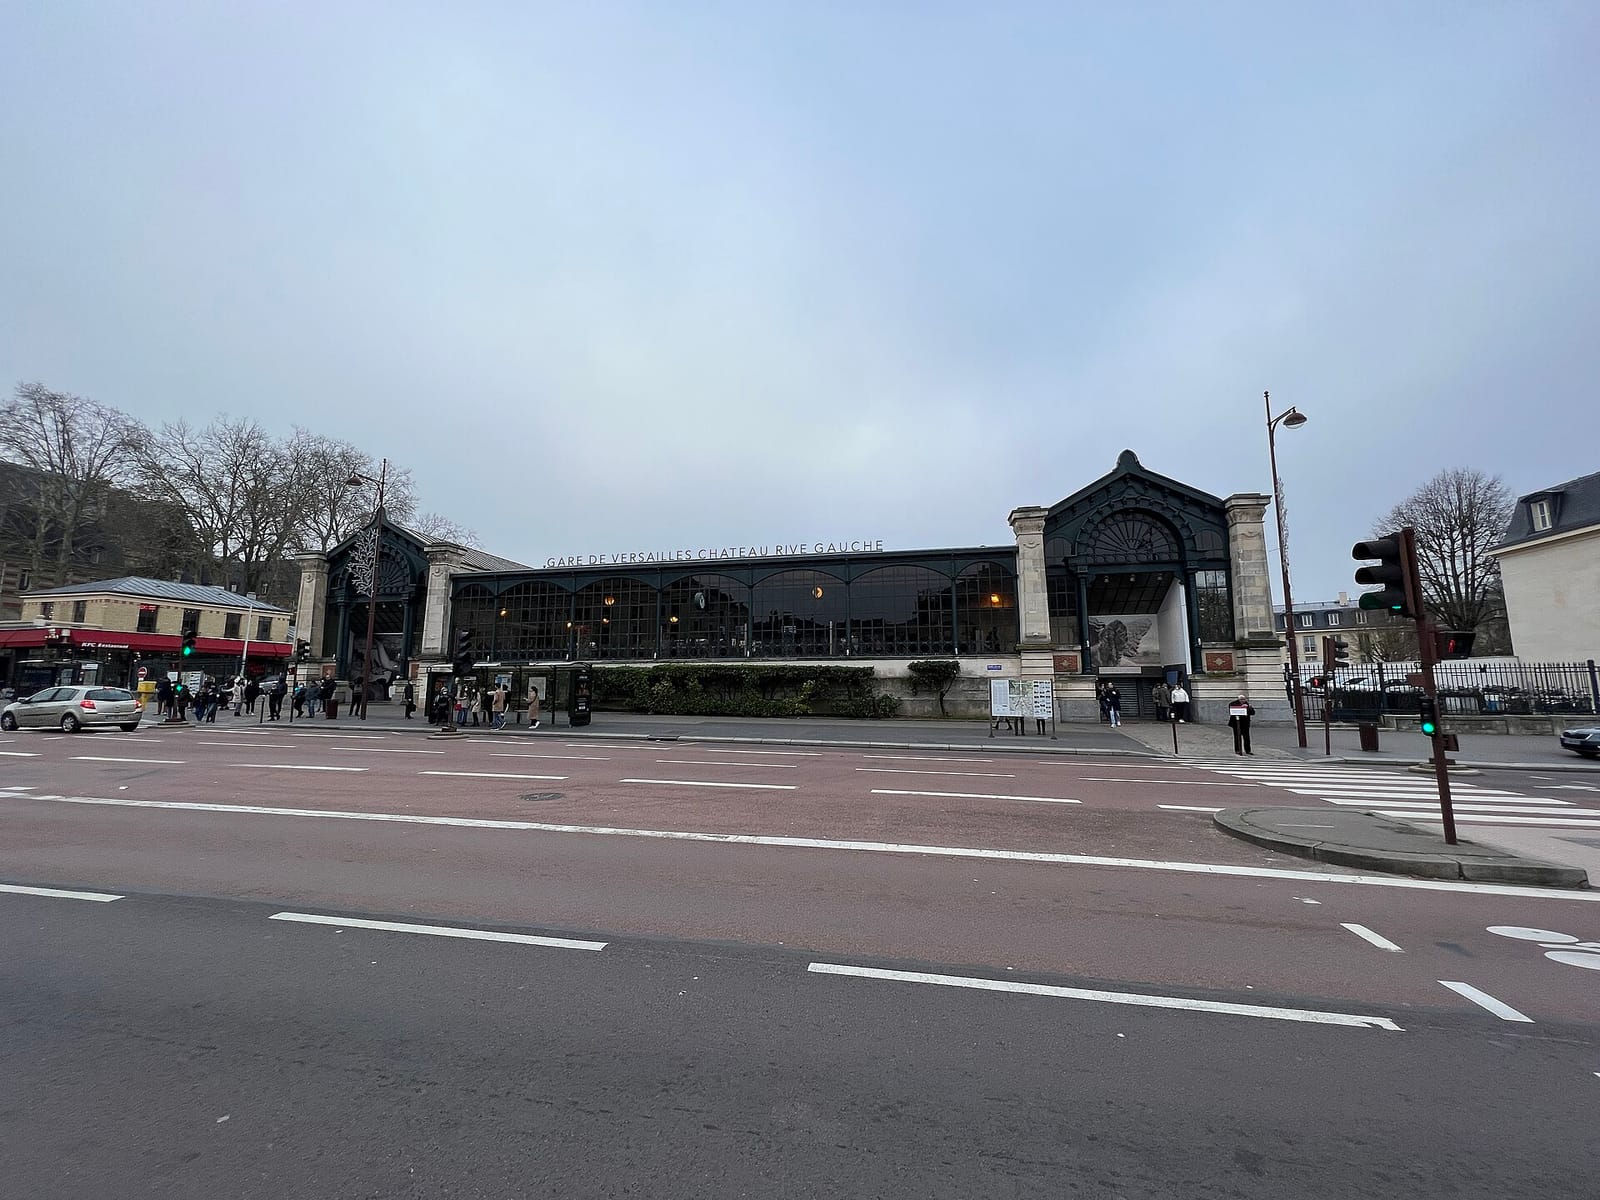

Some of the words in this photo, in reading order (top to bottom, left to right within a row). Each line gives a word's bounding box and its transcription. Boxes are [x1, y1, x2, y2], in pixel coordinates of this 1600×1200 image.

[546, 556, 583, 568] GARE
[589, 554, 606, 566] DE
[611, 550, 692, 564] VERSAILLES
[698, 546, 769, 560] CHATEAU
[775, 543, 808, 556] RIVE
[814, 540, 884, 554] GAUCHE
